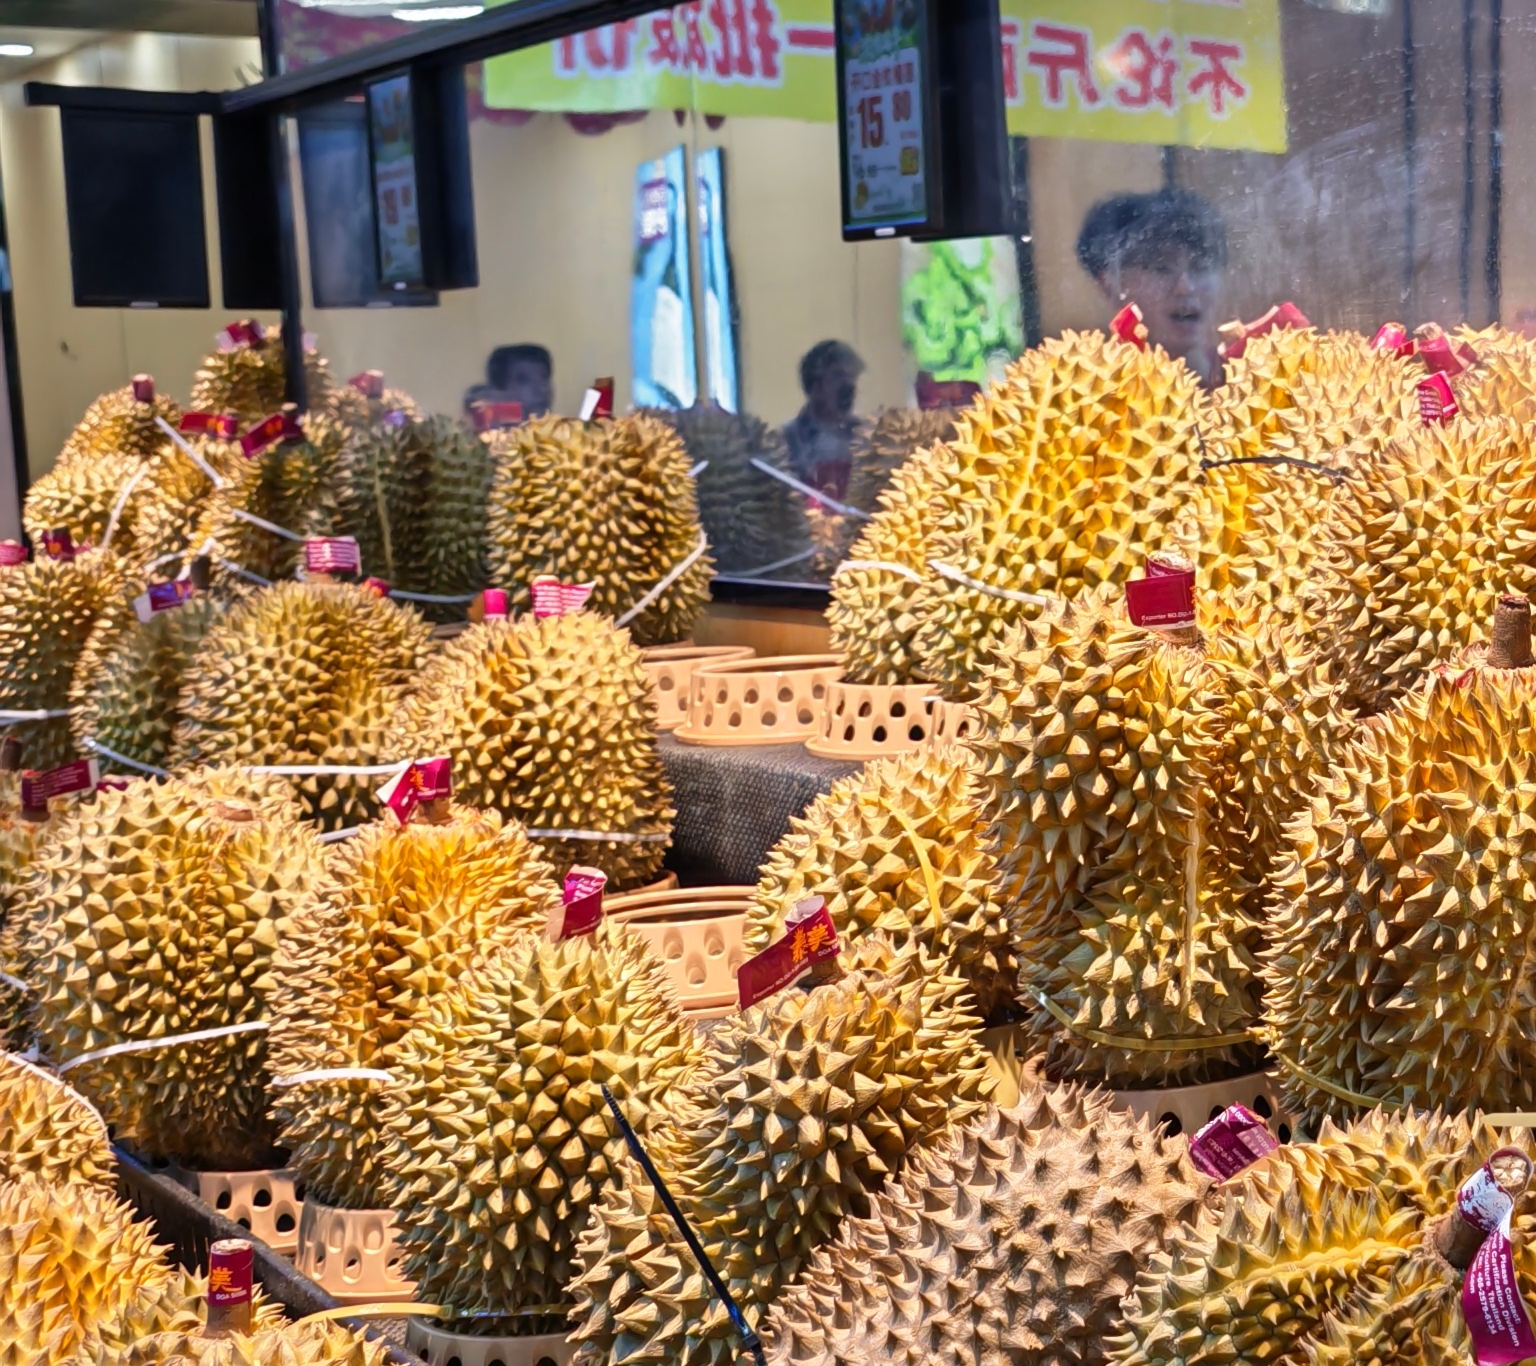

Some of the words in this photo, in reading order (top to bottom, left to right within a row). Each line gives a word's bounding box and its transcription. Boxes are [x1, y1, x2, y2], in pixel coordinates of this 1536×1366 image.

[1500, 1254, 1509, 1286] Please
[1488, 1290, 1505, 1331] Thailand
[1491, 1250, 1505, 1309] Certification
[1501, 1310, 1520, 1347] Division
[1504, 1287, 1521, 1325] Contact:
